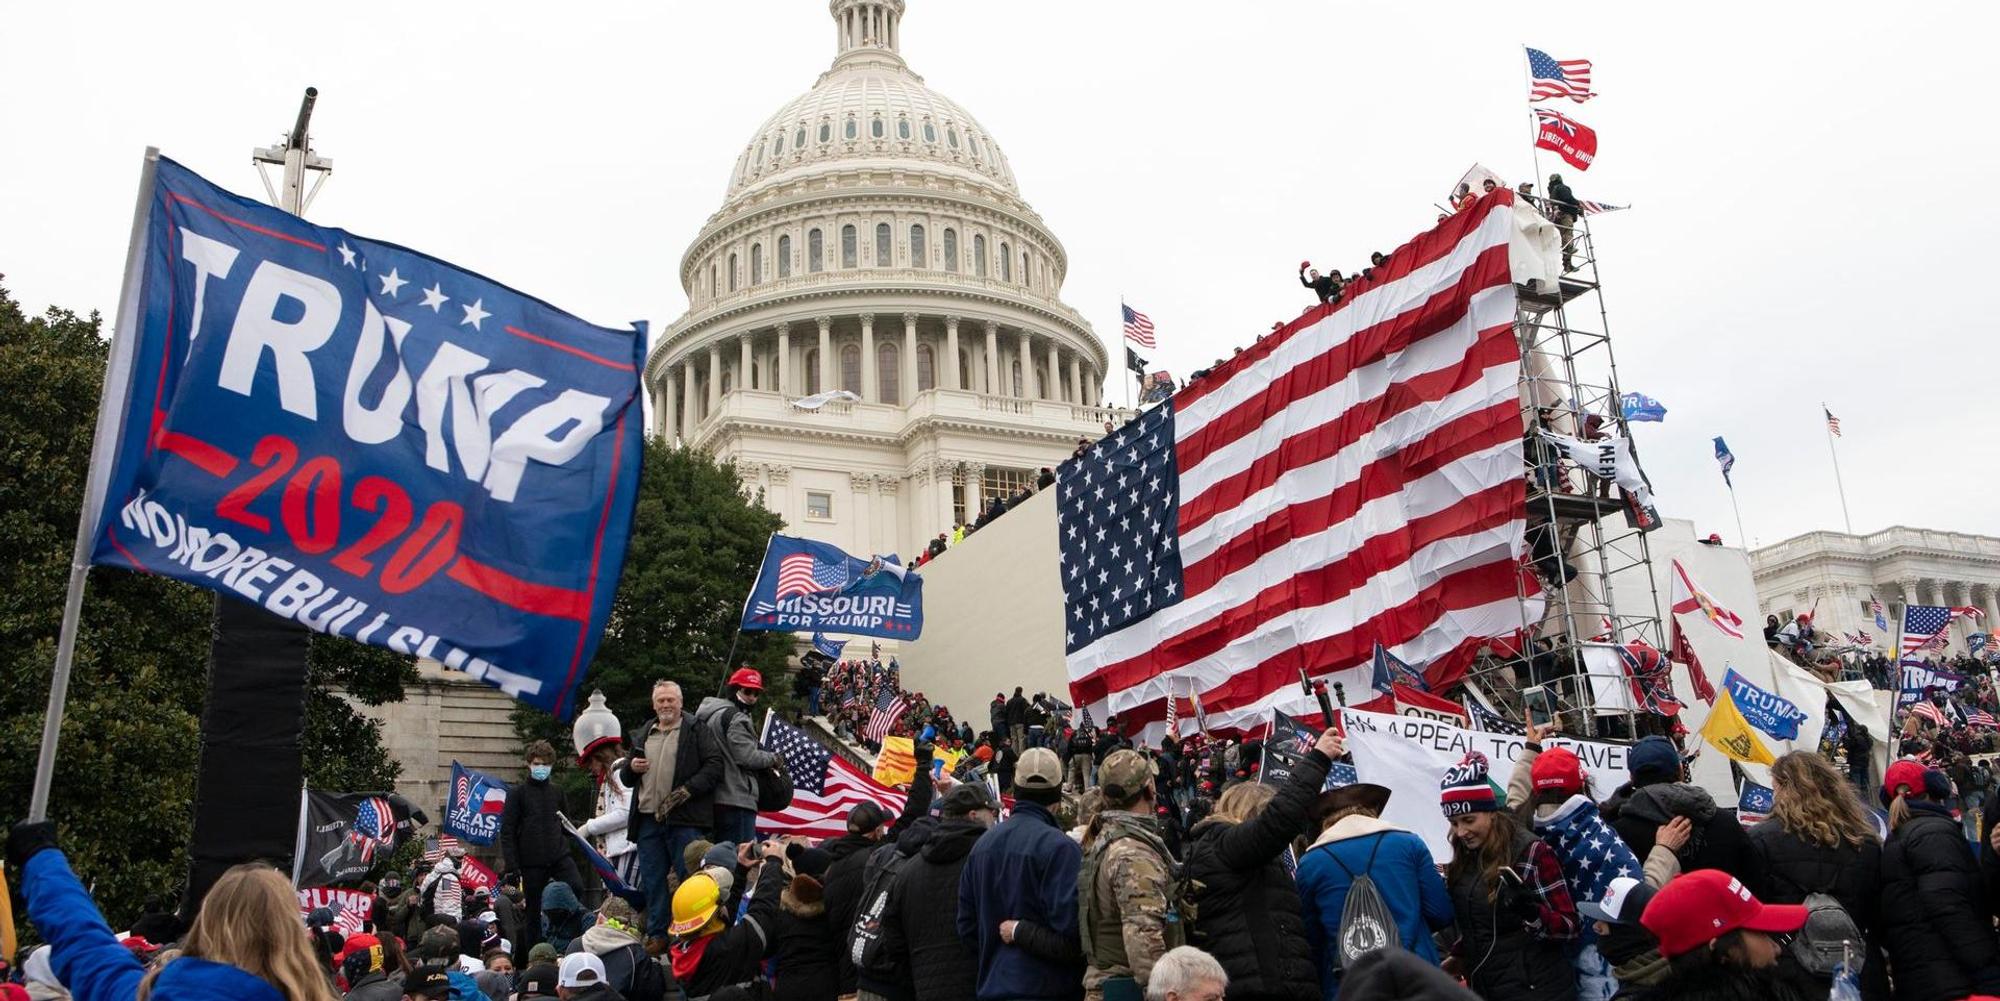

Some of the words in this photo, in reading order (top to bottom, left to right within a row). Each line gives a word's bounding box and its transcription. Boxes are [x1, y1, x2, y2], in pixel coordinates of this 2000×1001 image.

[178, 226, 612, 504] TRUMP
[121, 488, 175, 548] NO
[168, 513, 296, 603] MORE
[216, 434, 464, 595] 2020
[777, 614, 813, 627] FOR
[819, 614, 883, 628] TRUMP
[1735, 681, 1801, 720] TRUMP
[1490, 738, 1524, 763] TO
